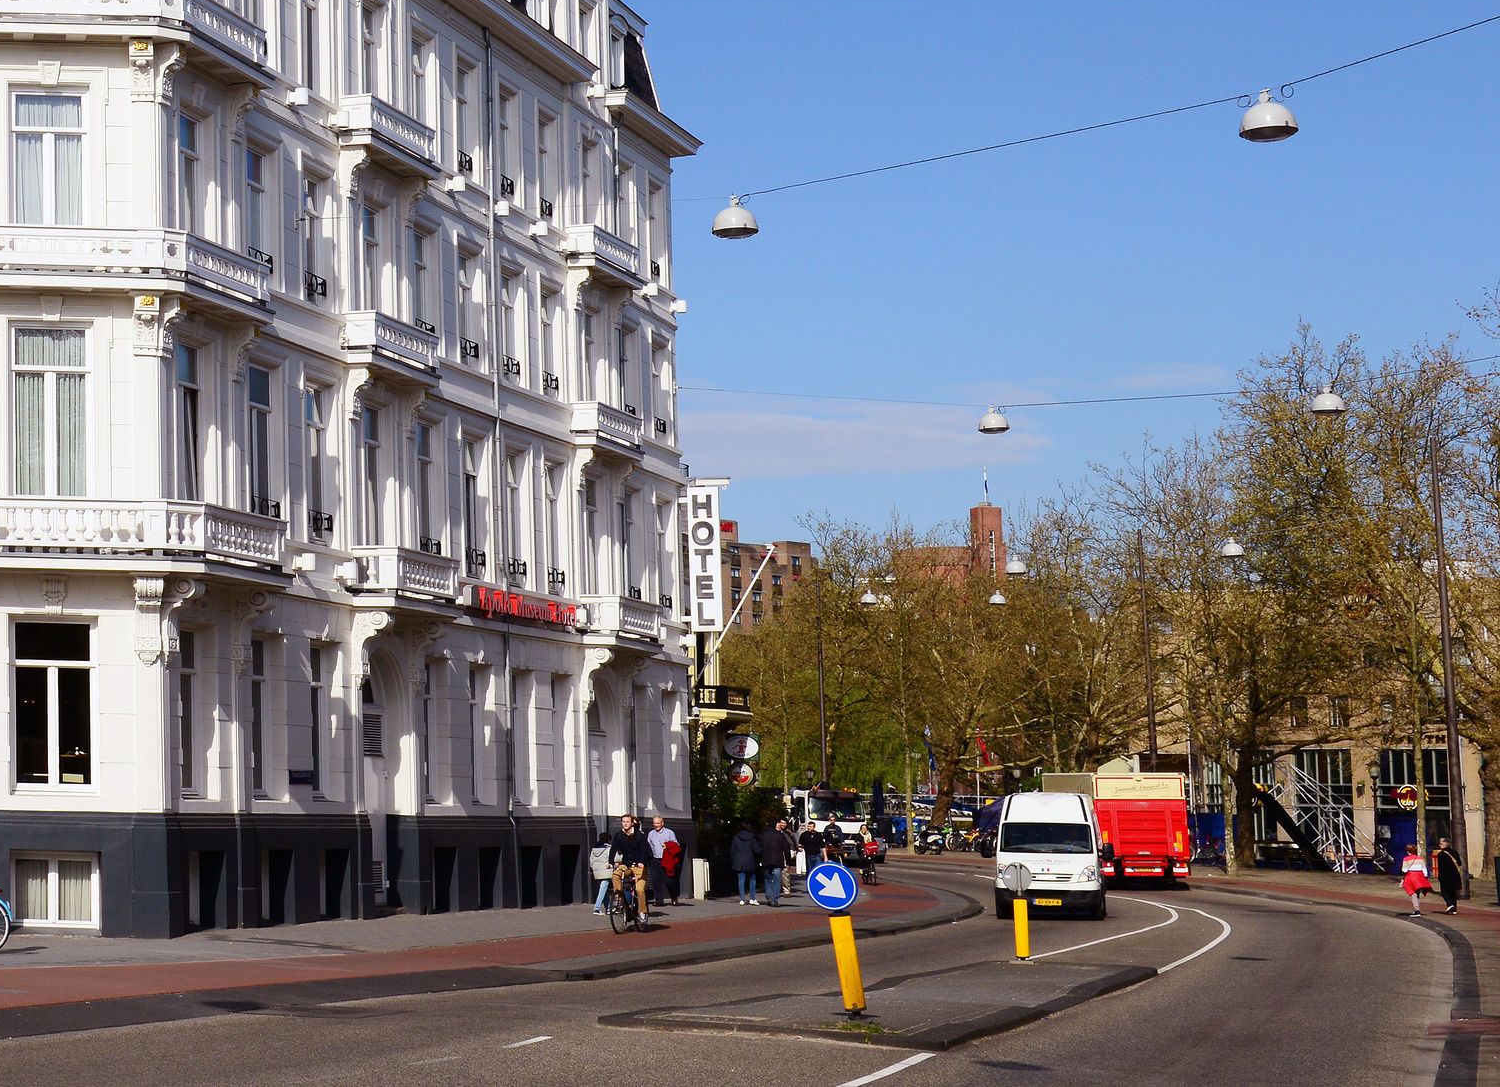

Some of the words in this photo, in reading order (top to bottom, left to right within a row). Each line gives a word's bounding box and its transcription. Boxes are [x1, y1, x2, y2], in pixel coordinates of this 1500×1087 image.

[691, 494, 715, 626] HOTEL
[479, 587, 514, 618] Apollo
[515, 595, 554, 620] Museum
[554, 601, 577, 626] Hotel
